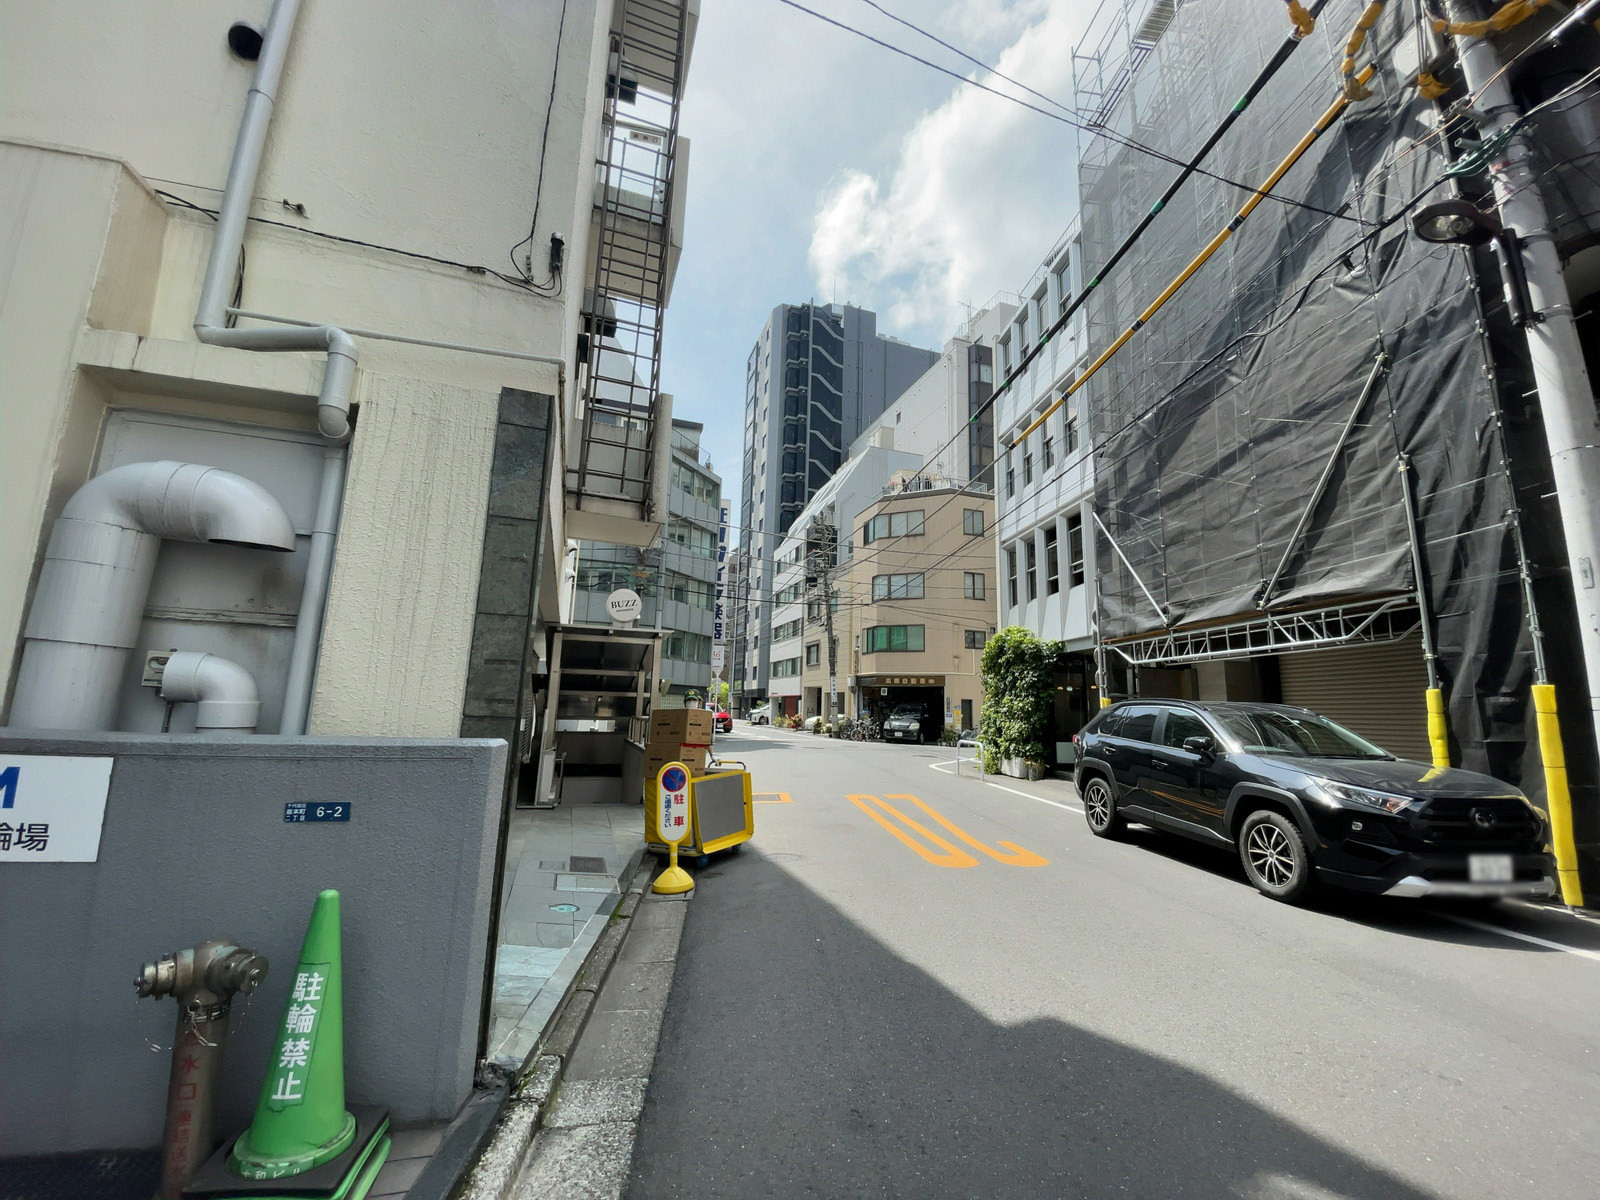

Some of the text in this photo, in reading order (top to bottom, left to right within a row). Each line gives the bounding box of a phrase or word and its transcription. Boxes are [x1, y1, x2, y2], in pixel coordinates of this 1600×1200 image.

[611, 599, 638, 609] BUZZ
[316, 806, 343, 818] 6-2
[272, 972, 324, 1100] 駐輪禁止
